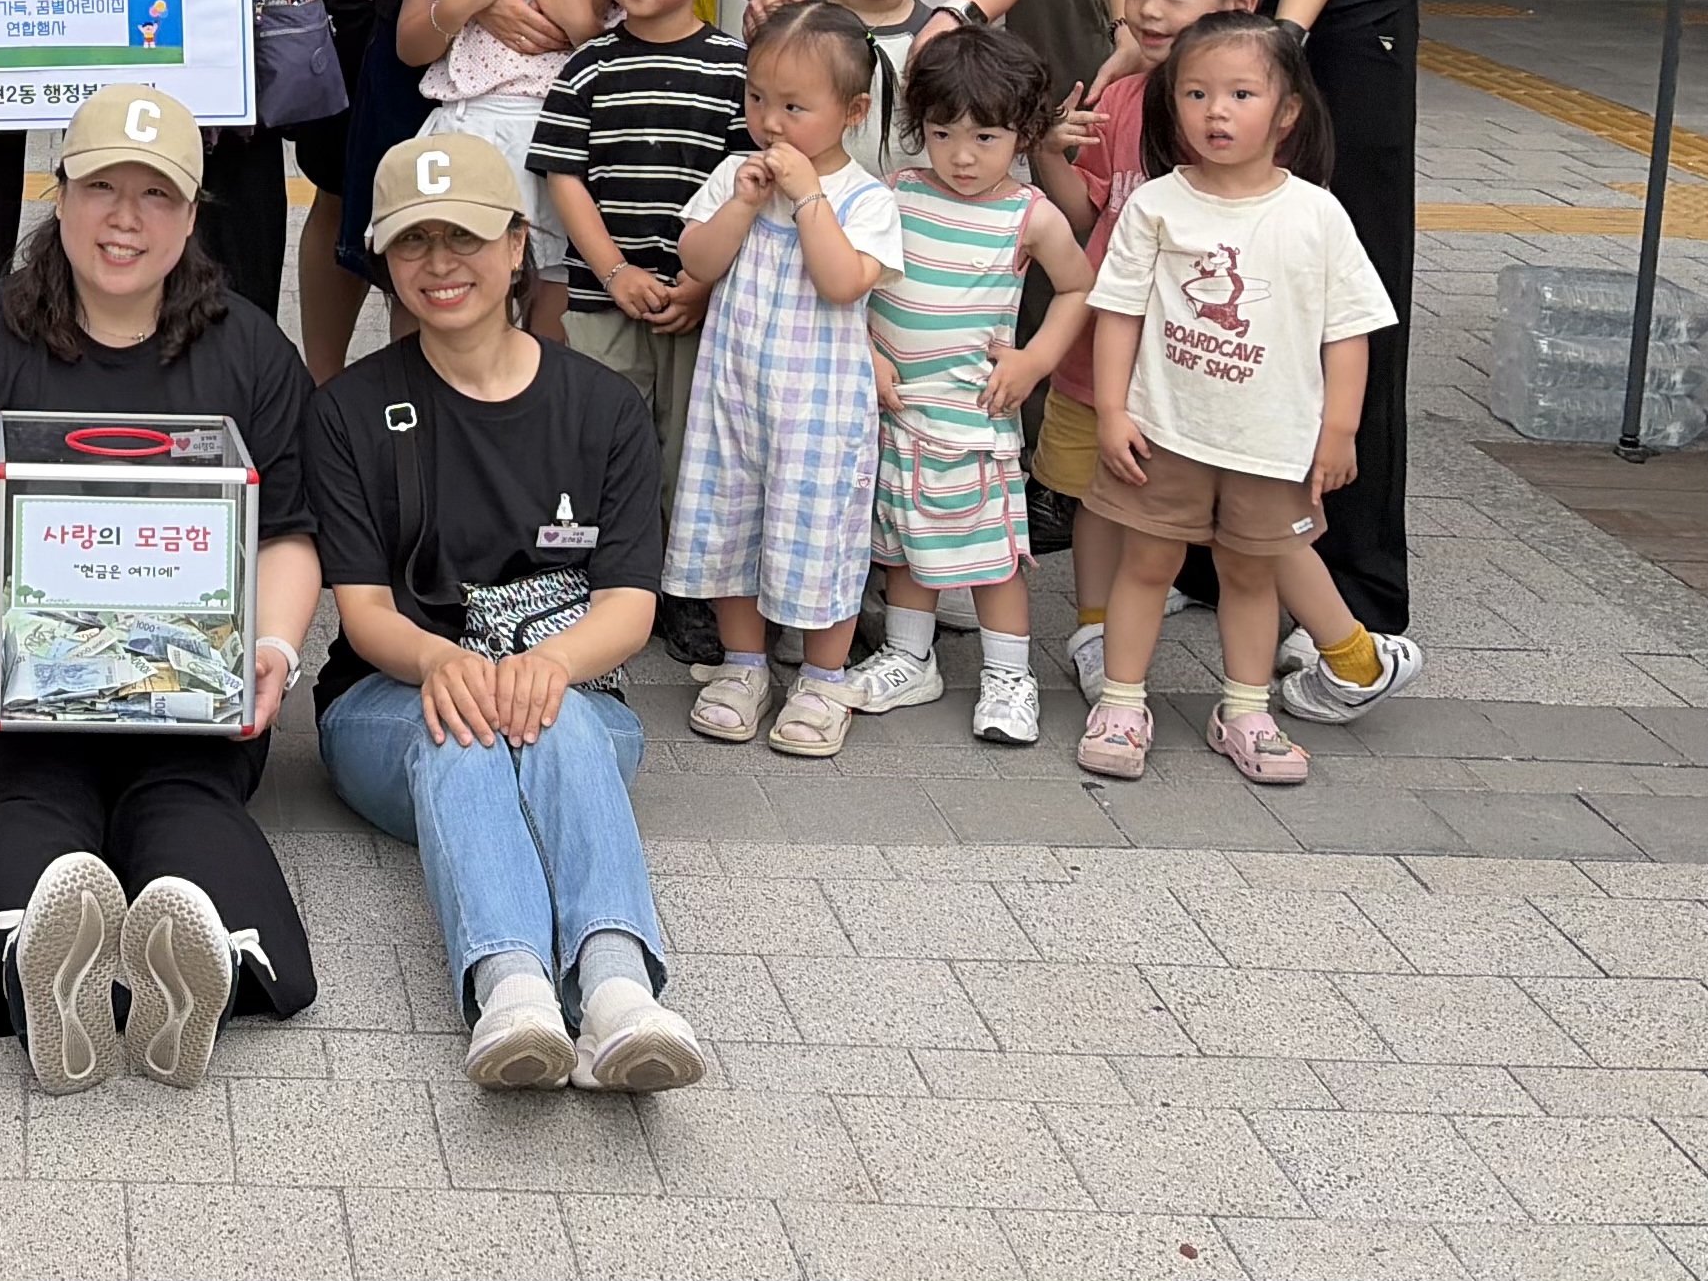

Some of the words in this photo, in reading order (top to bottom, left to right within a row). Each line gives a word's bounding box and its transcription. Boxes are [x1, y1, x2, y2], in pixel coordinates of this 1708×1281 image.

[6, 20, 67, 38] 연합행사
[124, 99, 161, 143] C
[416, 150, 451, 195] C
[1164, 320, 1266, 366] BOARDCAVE
[1165, 343, 1203, 371] SURF
[1203, 357, 1255, 384] SHOP
[43, 524, 122, 550] 사랑의
[134, 525, 212, 553] 모금함
[884, 667, 909, 688] N
